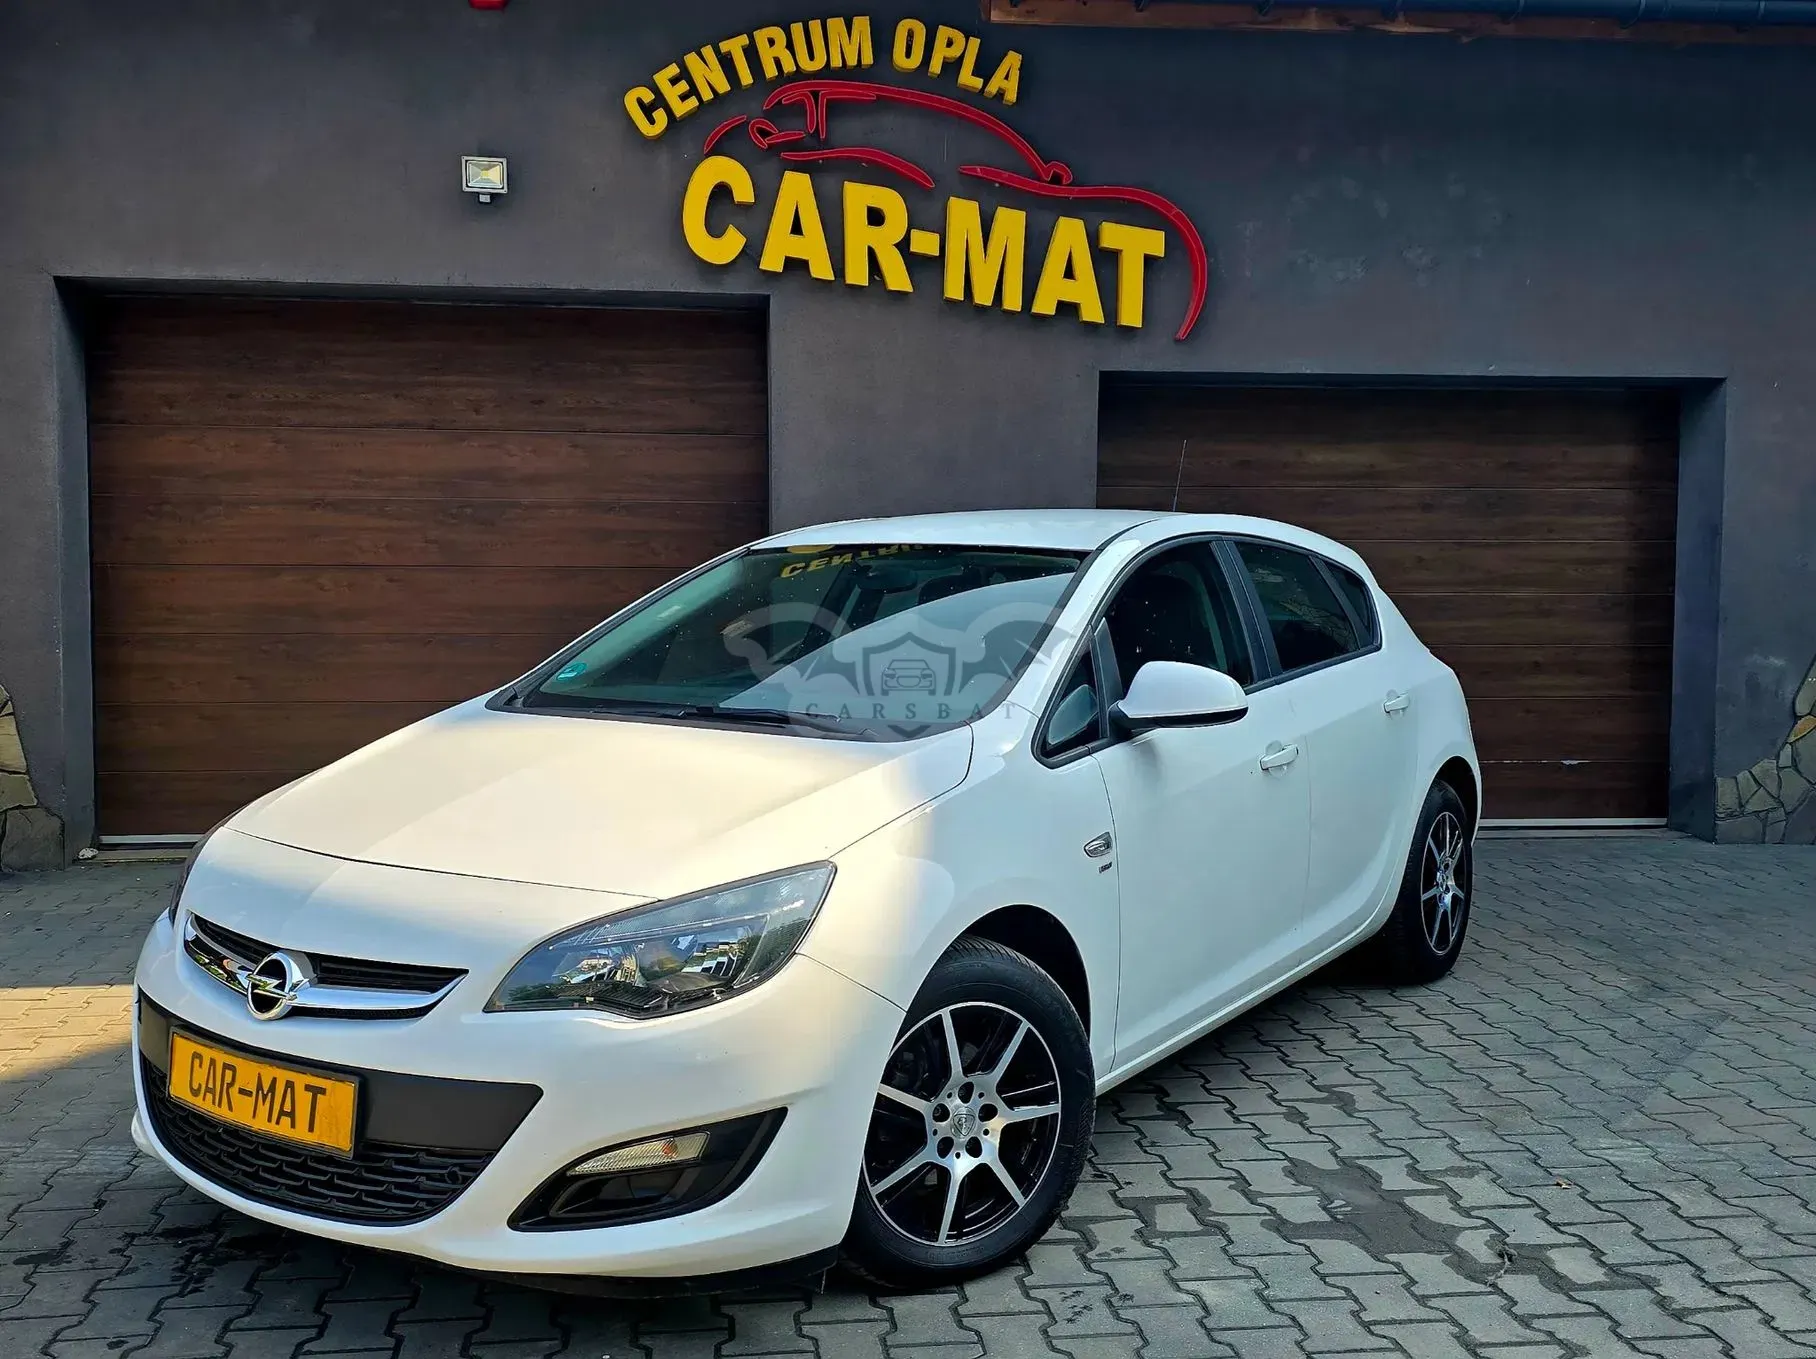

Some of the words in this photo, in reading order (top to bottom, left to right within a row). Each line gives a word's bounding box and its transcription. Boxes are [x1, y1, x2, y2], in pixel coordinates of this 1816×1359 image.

[624, 15, 874, 141] CENTRUM
[891, 18, 1023, 106] OPLA
[682, 154, 1165, 329] CAR-MAT
[188, 1051, 327, 1134] CAR-MAT
